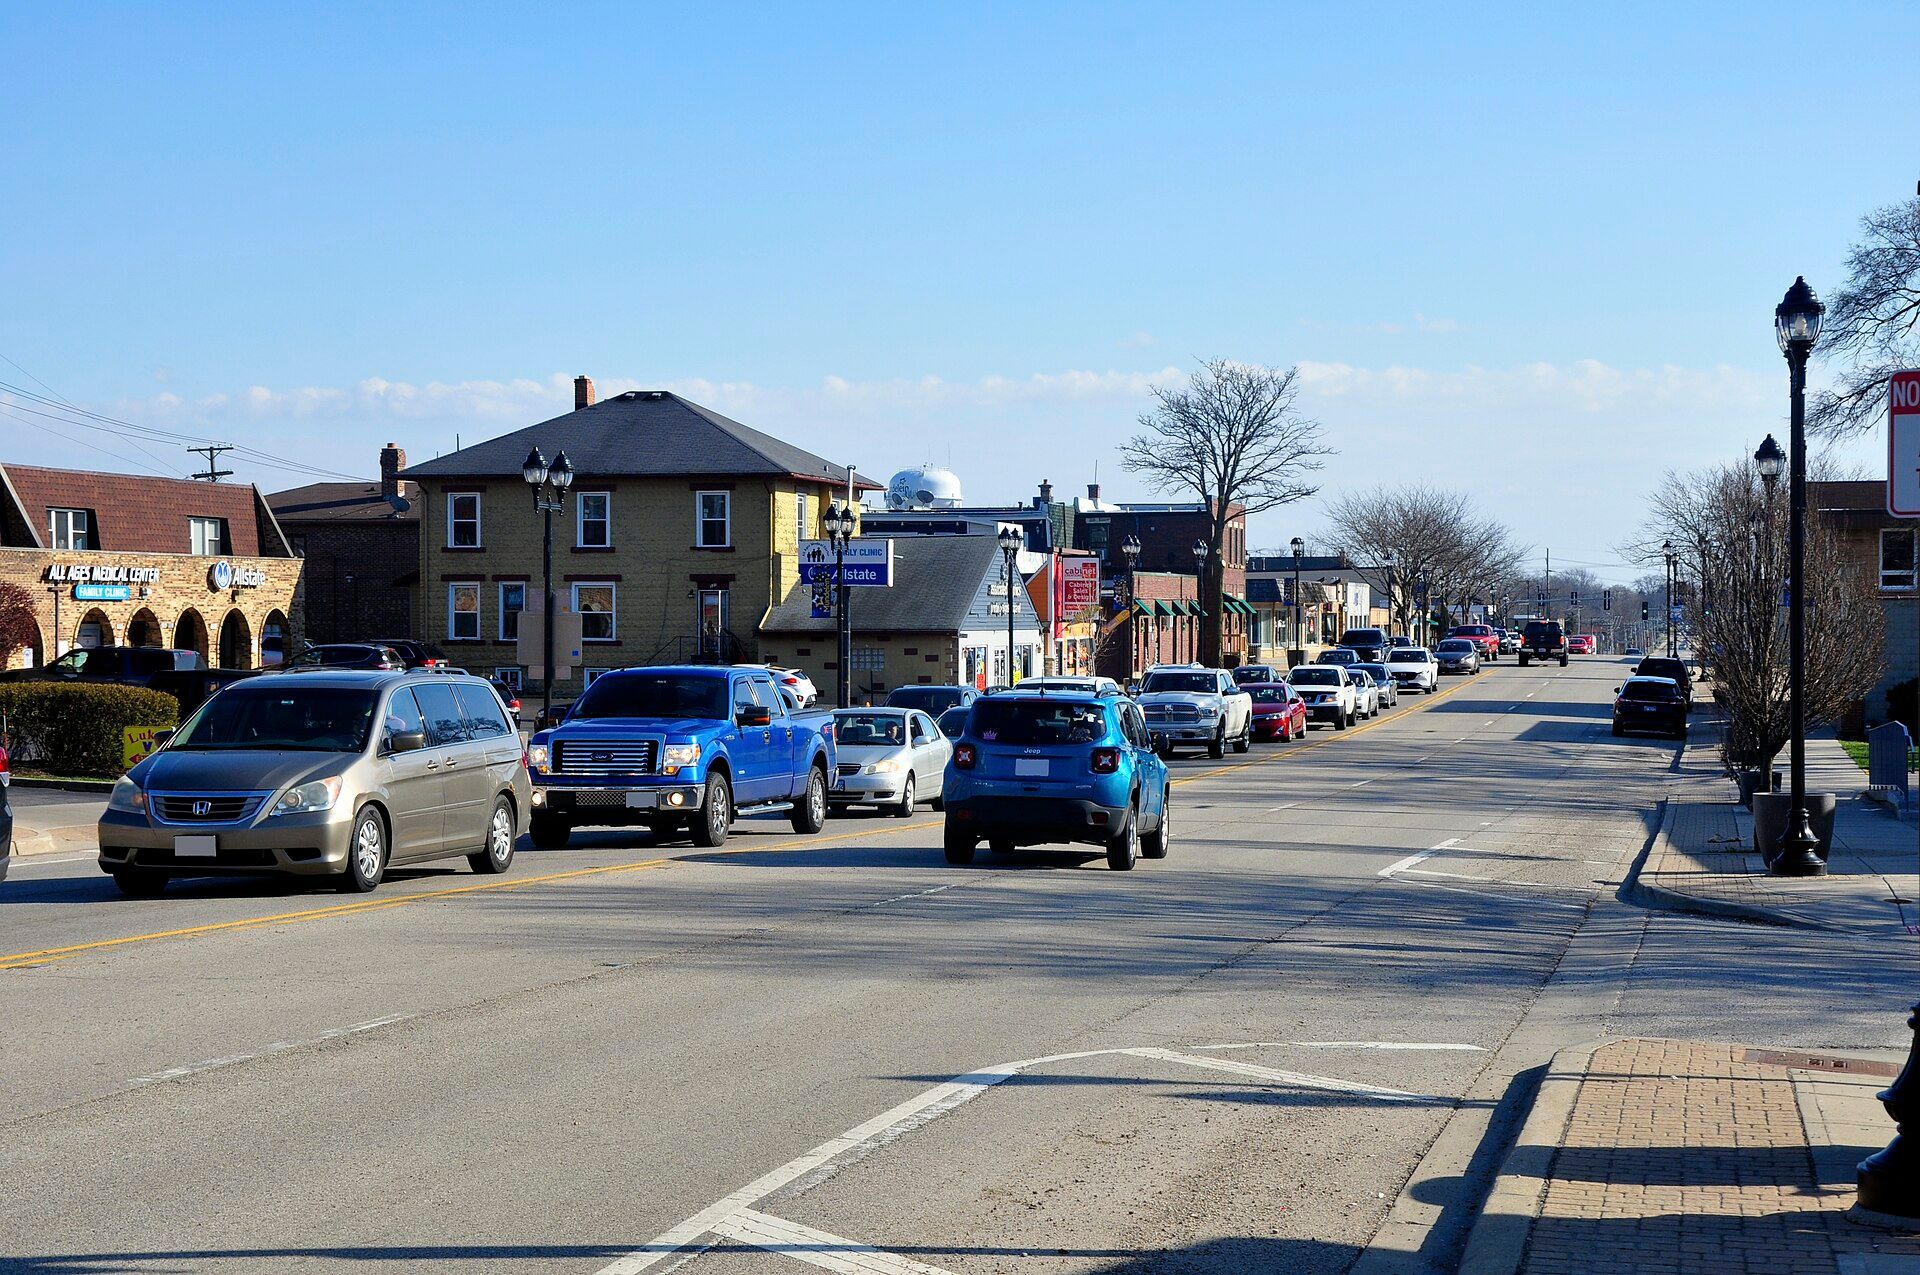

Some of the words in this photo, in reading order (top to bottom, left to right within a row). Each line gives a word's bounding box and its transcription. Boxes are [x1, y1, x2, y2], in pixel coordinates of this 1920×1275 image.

[1893, 380, 1920, 407] NO
[860, 548, 883, 557] CLINIC
[49, 565, 66, 580] ALL
[67, 565, 91, 581] AGES
[92, 566, 129, 582] MEDICAL
[130, 567, 160, 583] CENTER
[232, 568, 266, 586] Allstate
[831, 568, 877, 580] Alstate
[1065, 567, 1096, 575] cabinet
[79, 587, 104, 598] FAMILY
[105, 587, 127, 598] CLINIC
[128, 729, 155, 744] Luk
[1023, 747, 1041, 755] Jeep
